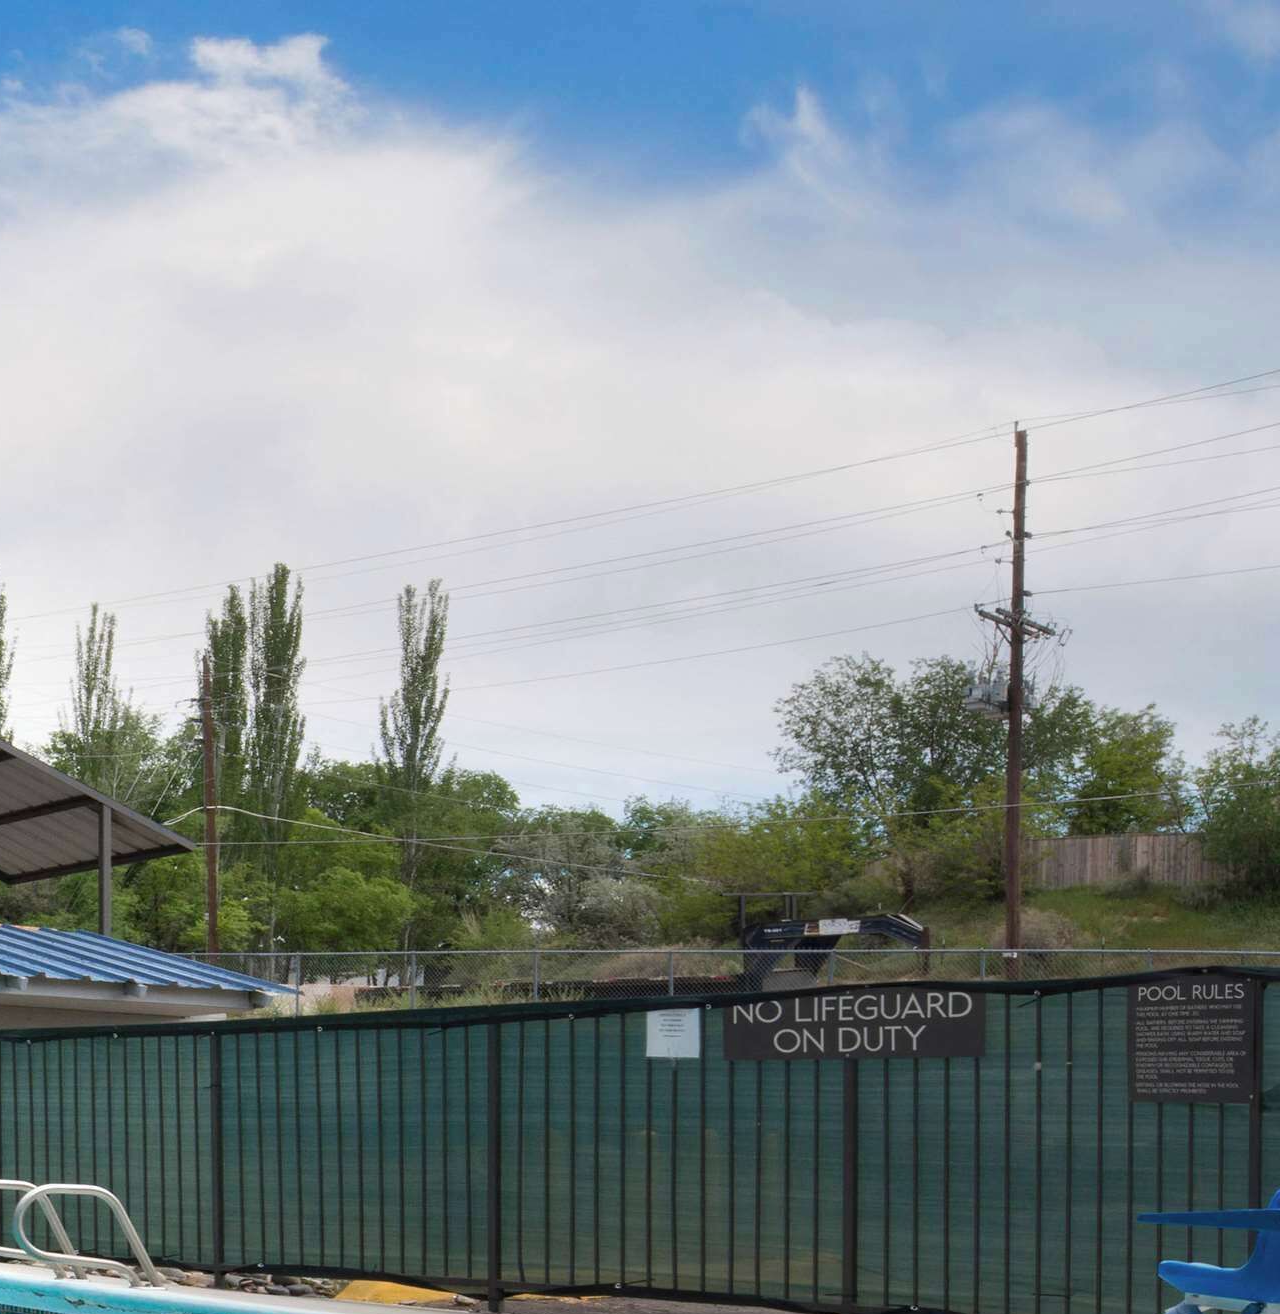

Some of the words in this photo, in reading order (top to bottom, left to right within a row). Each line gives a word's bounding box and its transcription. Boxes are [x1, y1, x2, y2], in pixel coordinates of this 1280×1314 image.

[1138, 986, 1186, 1001] POOL
[1192, 983, 1245, 1000] RULES
[733, 1001, 782, 1024] NO
[795, 992, 973, 1022] LIFEGUARD
[773, 1027, 825, 1053] ON
[838, 1024, 926, 1052] DUTY
